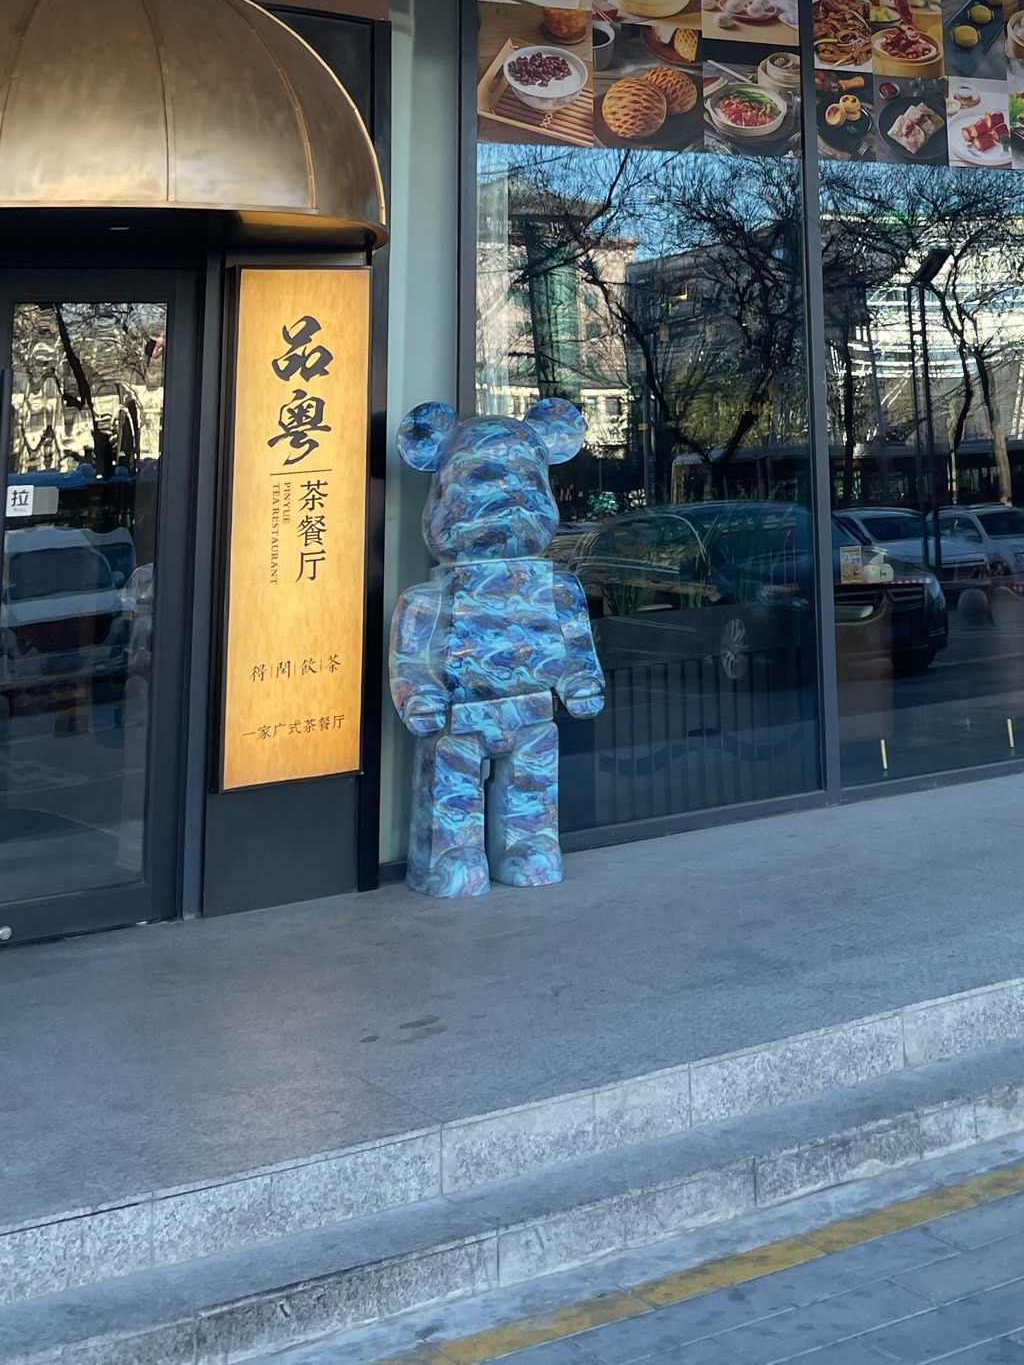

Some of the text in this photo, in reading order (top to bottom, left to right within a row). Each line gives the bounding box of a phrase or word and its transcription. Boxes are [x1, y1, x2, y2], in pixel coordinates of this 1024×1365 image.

[267, 315, 333, 466] 品粤
[12, 490, 29, 507] 拉
[270, 483, 280, 585] TEA RESTAURANT
[283, 482, 291, 524] PINYUE
[295, 480, 328, 583] 茶餐厅
[241, 714, 345, 741] 一家广式茶餐厅
